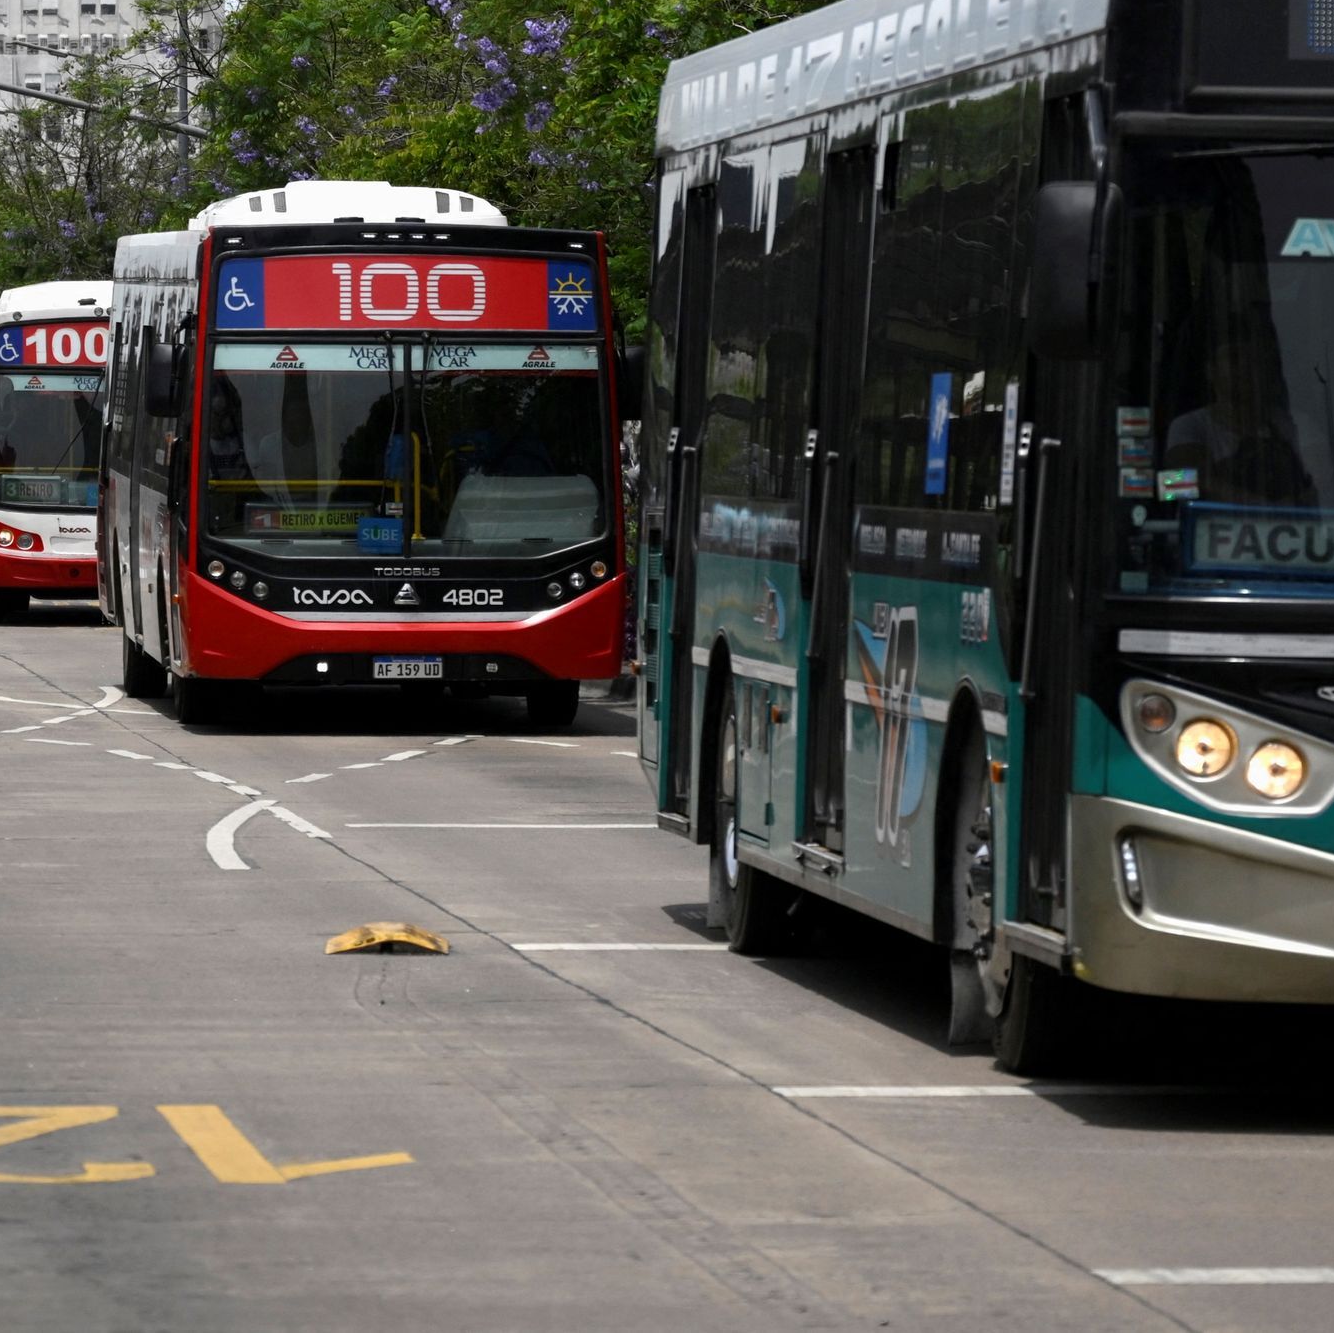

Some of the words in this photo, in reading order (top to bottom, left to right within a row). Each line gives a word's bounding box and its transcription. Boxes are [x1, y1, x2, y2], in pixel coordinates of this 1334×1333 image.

[681, 53, 778, 145] WILDE
[783, 31, 844, 120] 17
[331, 262, 487, 322] 100
[25, 326, 110, 365] 100
[349, 346, 396, 358] MEGA
[430, 346, 477, 358] MEGA
[356, 356, 389, 369] CAR
[437, 356, 470, 369] CAR
[522, 361, 556, 369] AGRALE
[6, 482, 17, 497] 3
[19, 483, 53, 497] RETIRO
[255, 513, 272, 528] 1
[281, 513, 316, 526] RETIRO
[361, 527, 399, 542] SUBE
[374, 567, 441, 577] TODOBUS
[442, 588, 504, 606] 4802
[377, 663, 392, 677] AF
[397, 663, 420, 677] 159
[424, 663, 440, 677] UD
